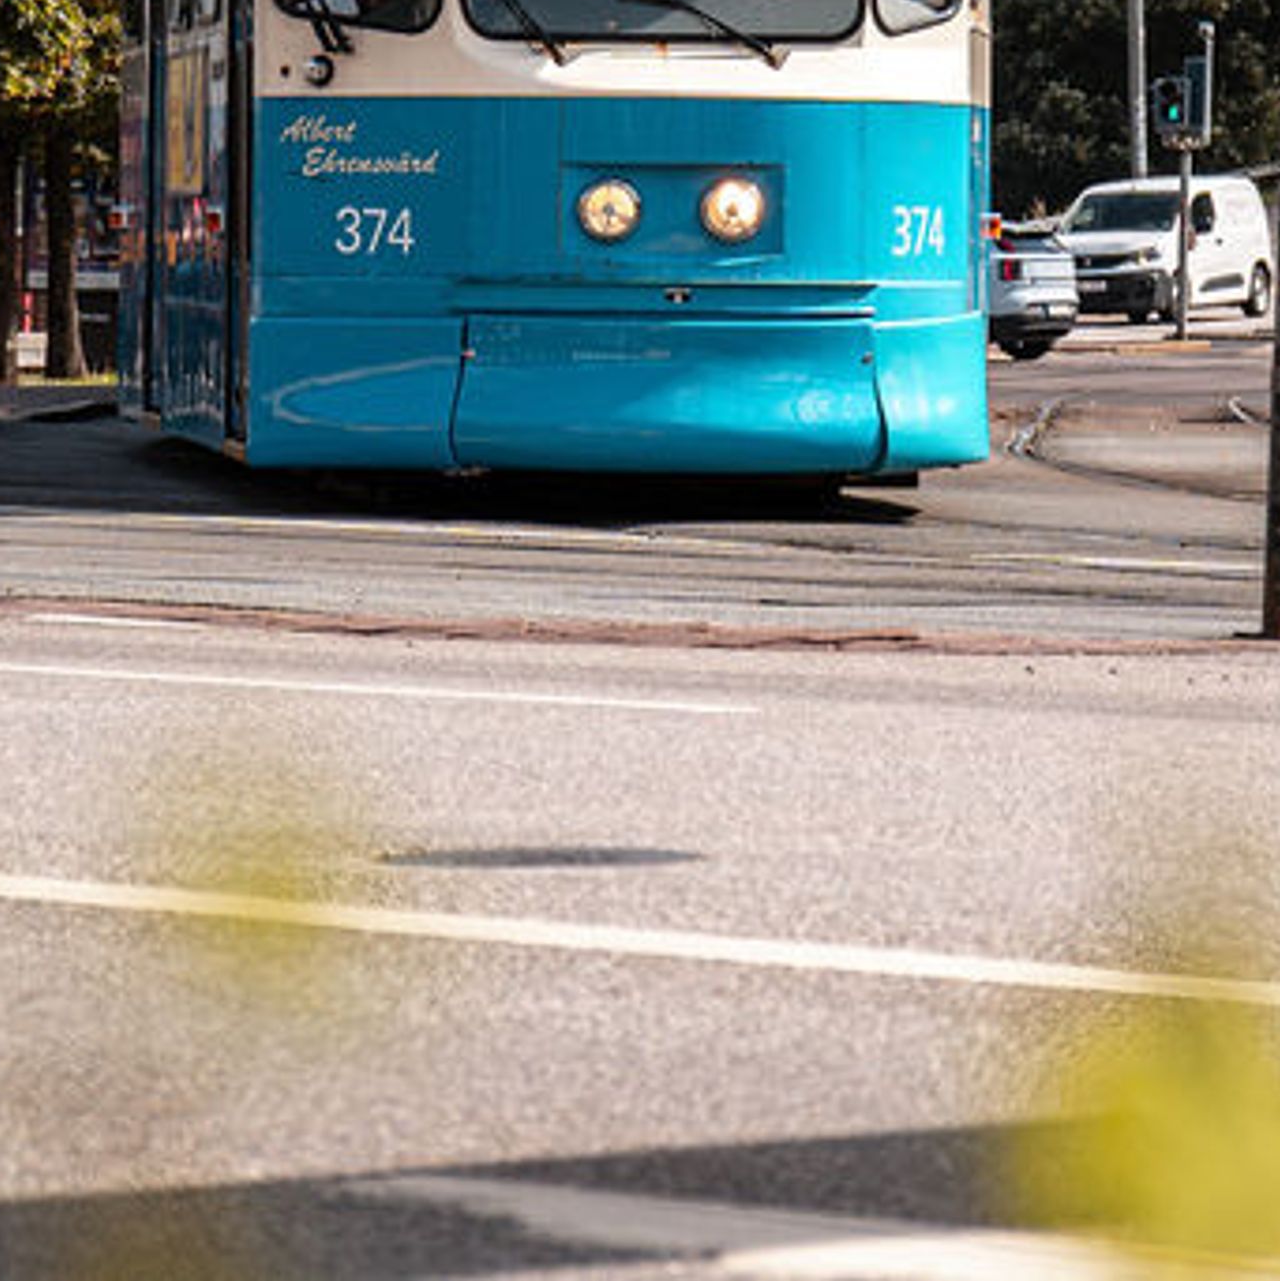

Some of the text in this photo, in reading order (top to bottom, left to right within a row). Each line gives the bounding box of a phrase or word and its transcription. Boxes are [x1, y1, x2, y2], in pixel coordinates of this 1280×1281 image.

[280, 114, 357, 143] Albert
[334, 205, 417, 255] 374
[891, 204, 946, 256] 374
